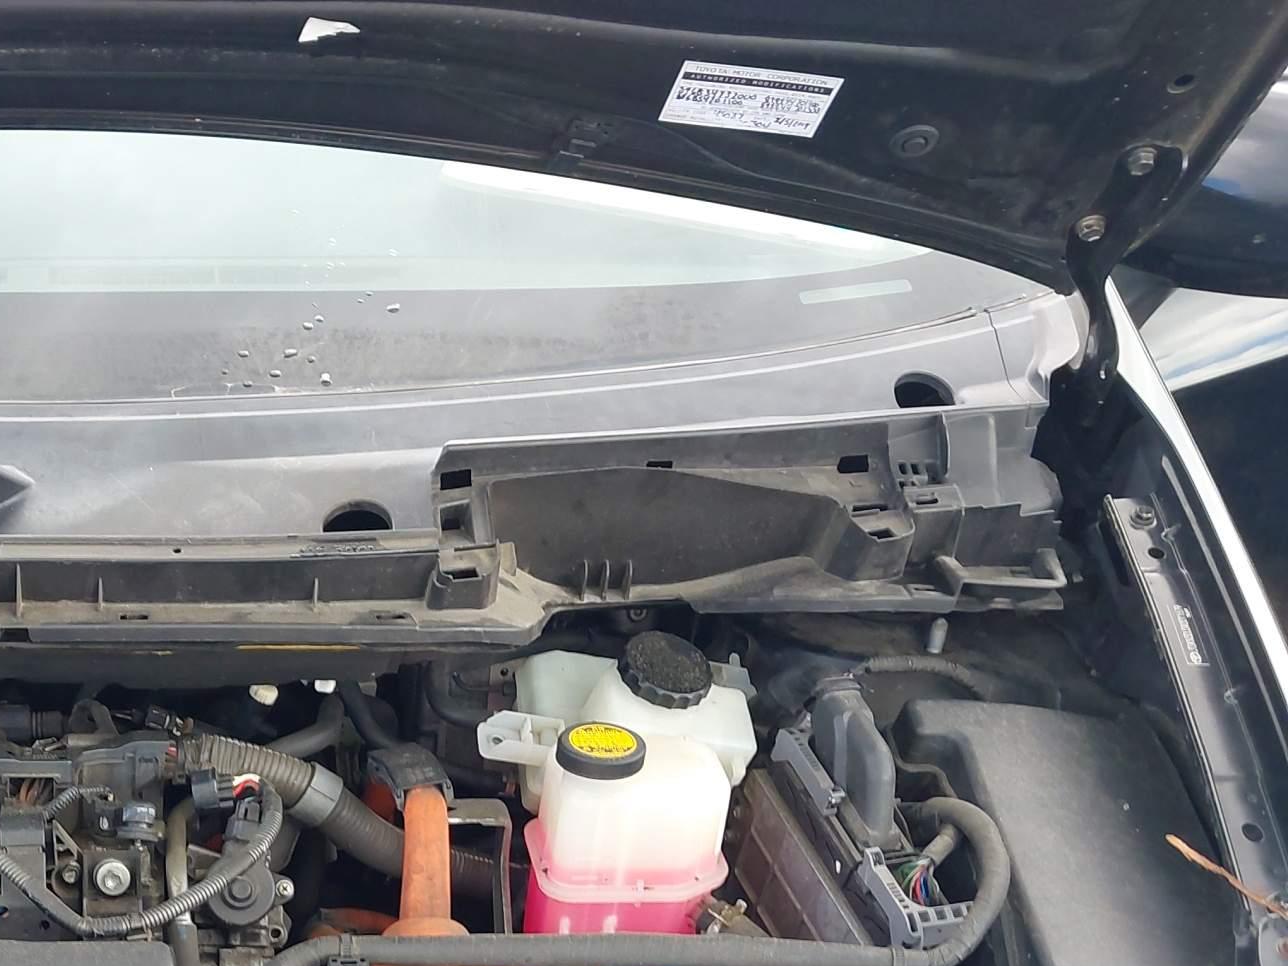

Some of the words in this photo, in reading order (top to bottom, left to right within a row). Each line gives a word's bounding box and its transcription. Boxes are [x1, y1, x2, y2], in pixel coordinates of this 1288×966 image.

[691, 74, 747, 84] AUTHORIZED
[752, 80, 825, 94] MODIFICATIONS
[696, 65, 728, 74] TOYOTA
[732, 69, 761, 78] MOTOR
[767, 73, 828, 86] CORPORATION
